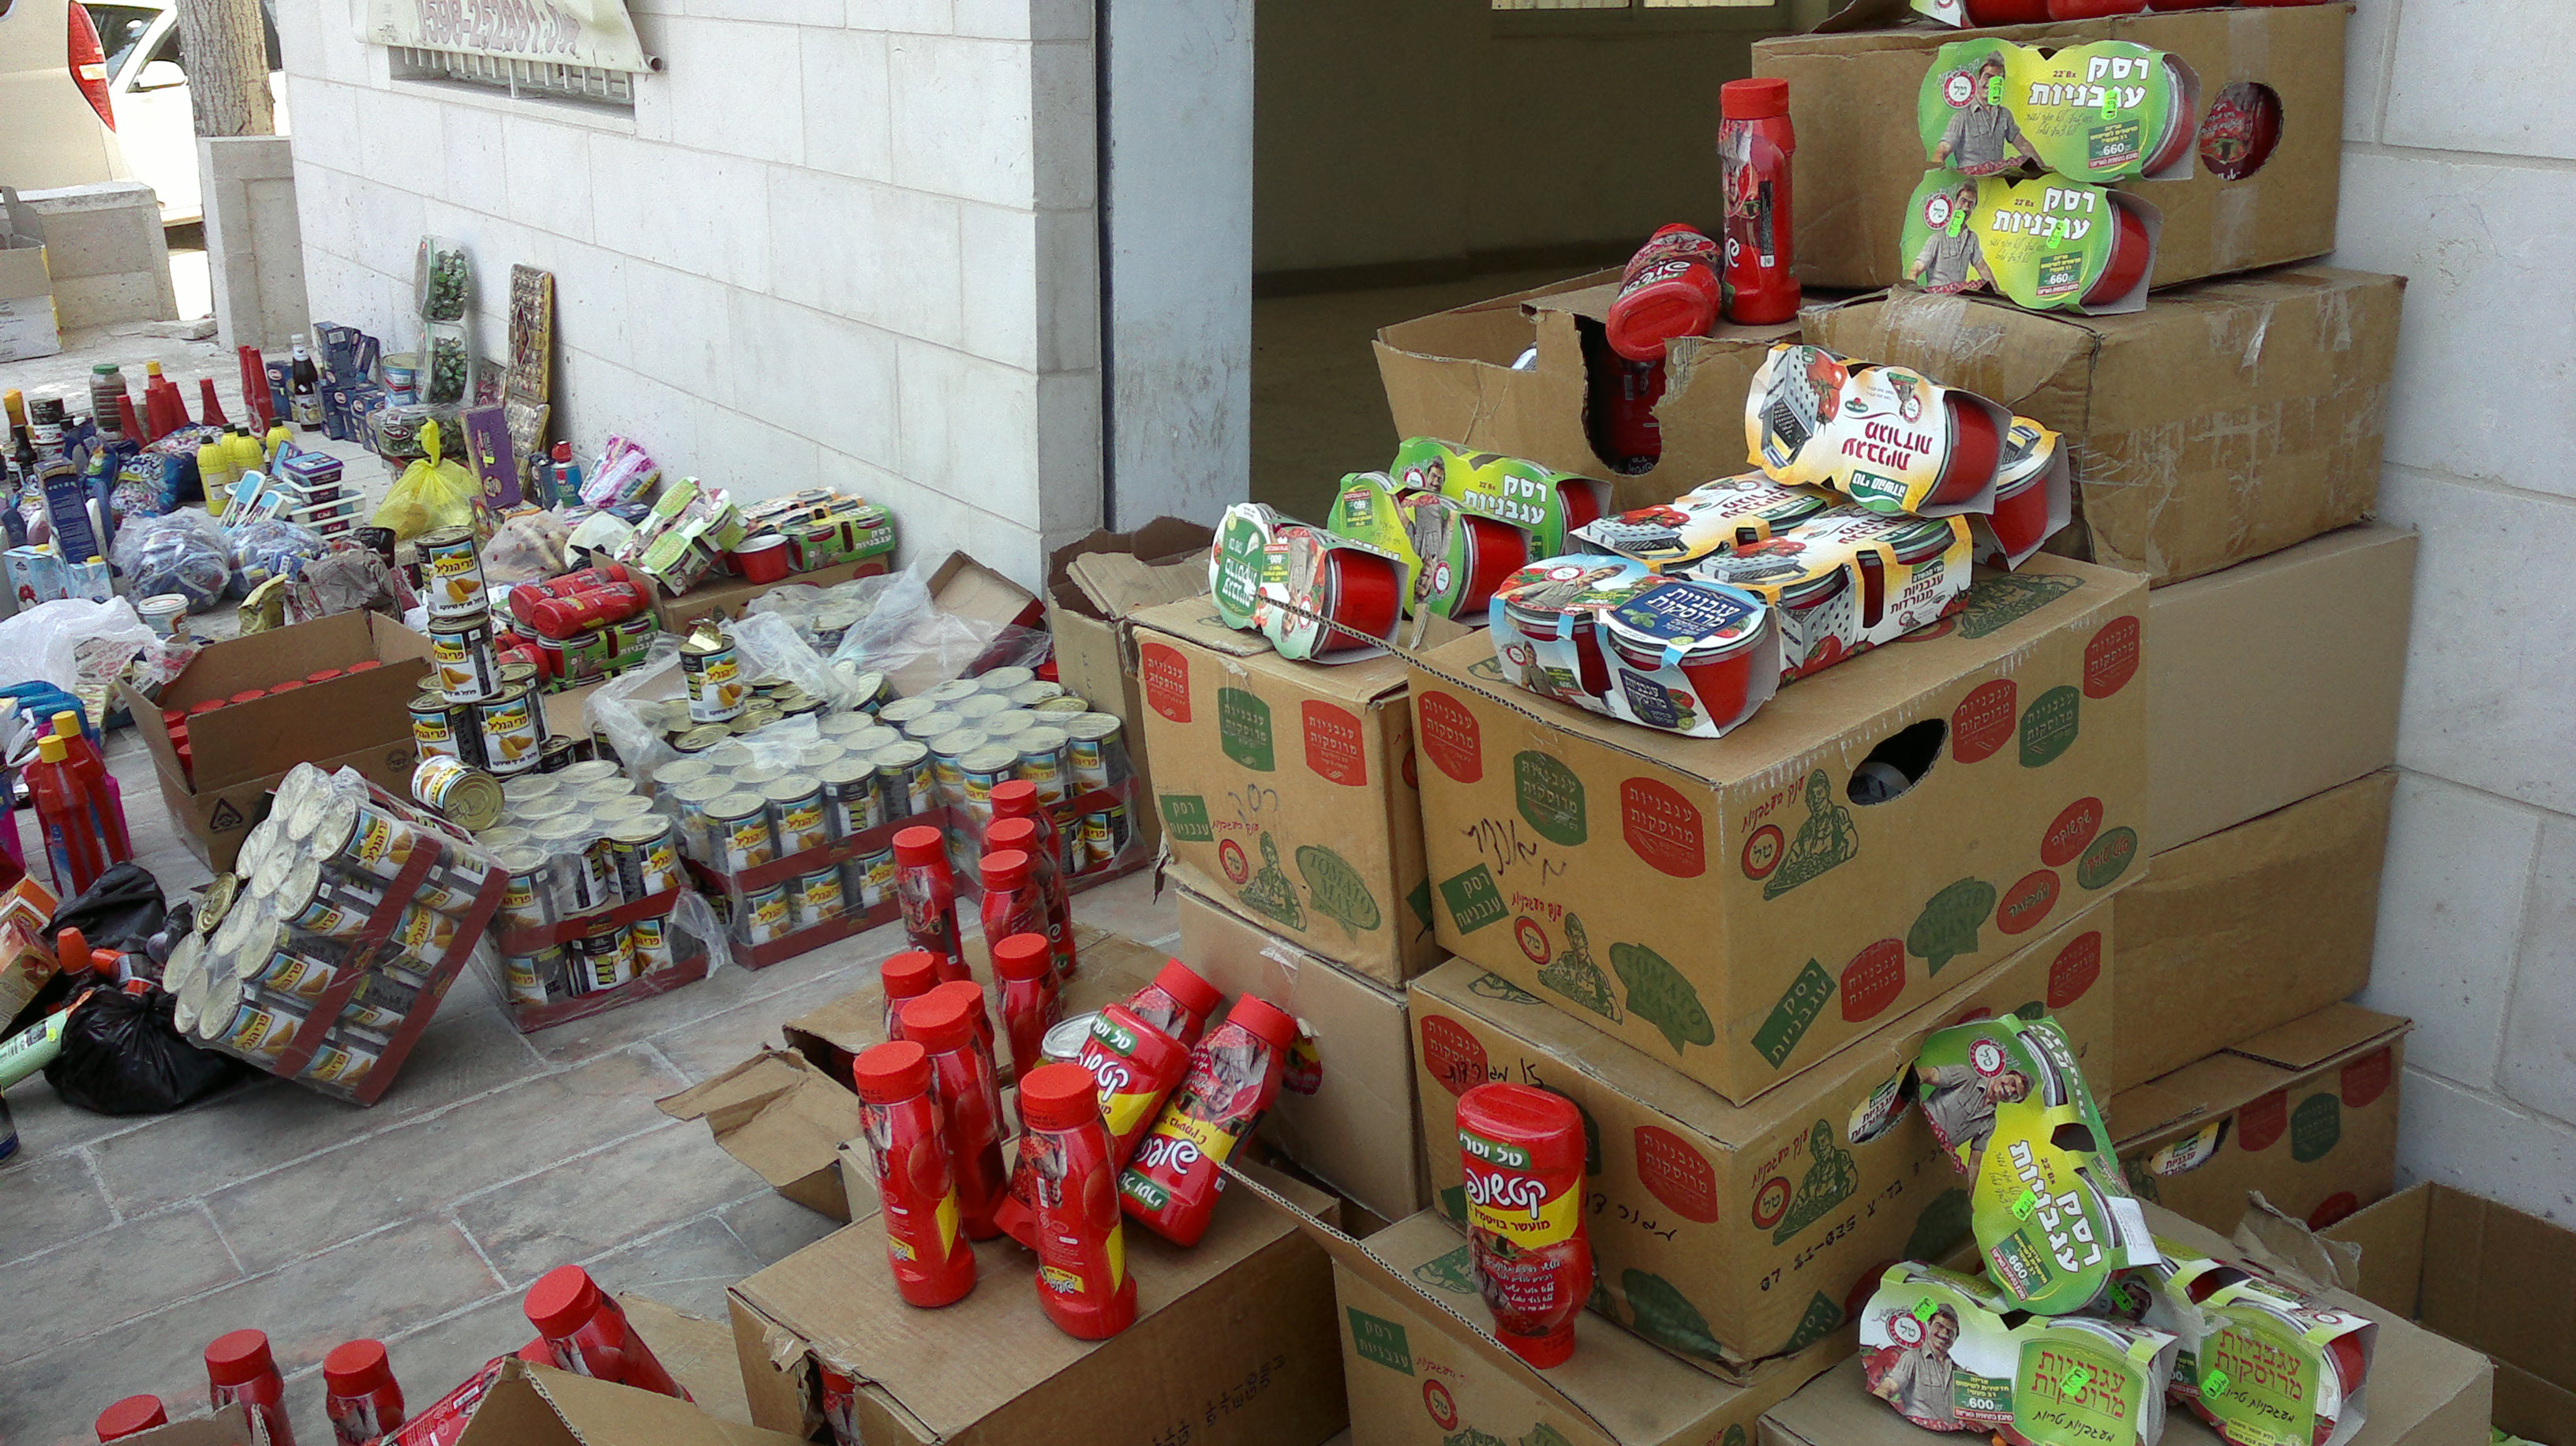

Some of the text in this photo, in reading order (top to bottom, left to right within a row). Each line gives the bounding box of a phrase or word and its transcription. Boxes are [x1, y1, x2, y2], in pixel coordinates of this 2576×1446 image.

[2086, 56, 2150, 83] רסק
[2042, 186, 2095, 213] רסק
[1864, 421, 1934, 455] מגורדות
[1841, 438, 1911, 471] עגבניות
[1503, 474, 1547, 503] רסק
[1463, 489, 1547, 525] עגבניות
[435, 558, 474, 574] פרי הגליל
[1667, 587, 1743, 616] עגבניות
[1890, 589, 1934, 614] מגורדות
[1904, 573, 1944, 598] עגבניות
[1647, 595, 1727, 628] מרוסקות
[2091, 624, 2136, 653] עגבניות
[451, 650, 465, 661] פרי
[2091, 641, 2135, 671] מרוסקות
[1424, 698, 1473, 730] עגבניות
[1960, 684, 2012, 717] עגבניות
[2026, 692, 2074, 725] עגבניות
[489, 716, 528, 732] פרי הגליל
[1308, 715, 1355, 740] עגבניות
[1426, 717, 1475, 749] מרוסקות
[1960, 702, 2011, 734] מרוסקות
[2026, 710, 2074, 741] מרוסקות
[1309, 730, 1357, 755] מרוסקות
[1172, 802, 1196, 818] רסק
[1629, 786, 1693, 822] עגבניות
[1169, 822, 1210, 837] עגבניות
[1631, 807, 1694, 844] מרוסקות
[2051, 808, 2093, 848] שקשוקה
[1753, 843, 1773, 864] טל
[1462, 872, 1491, 900] רסק
[1455, 896, 1501, 928] עגבניות
[1848, 953, 1899, 991] עגבניות
[1849, 970, 1899, 1006] מגורדות
[1782, 969, 1818, 1016] רסק
[1770, 979, 1829, 1062] עגבניות
[1111, 1030, 1132, 1050] טל
[1428, 1019, 1481, 1056] עגבניות
[1076, 1051, 1129, 1103] קטשו
[1458, 1132, 1523, 1167] טל וטרי
[1643, 1133, 1706, 1174] עגבניות
[1646, 1152, 1708, 1193] מרוסקות
[1466, 1167, 1548, 1220] קטשופ
[1762, 1194, 1782, 1214] טל
[2009, 1140, 2080, 1273] עגבניות
[1510, 1219, 1551, 1232] מועשר
[2054, 1189, 2102, 1267] רסק
[1364, 1320, 1393, 1341] רסק
[1360, 1338, 1410, 1368] עגבניות
[2219, 1329, 2302, 1377] עגבניות
[2214, 1349, 2304, 1401] מרוסקות
[1968, 1397, 1995, 1410] 600
